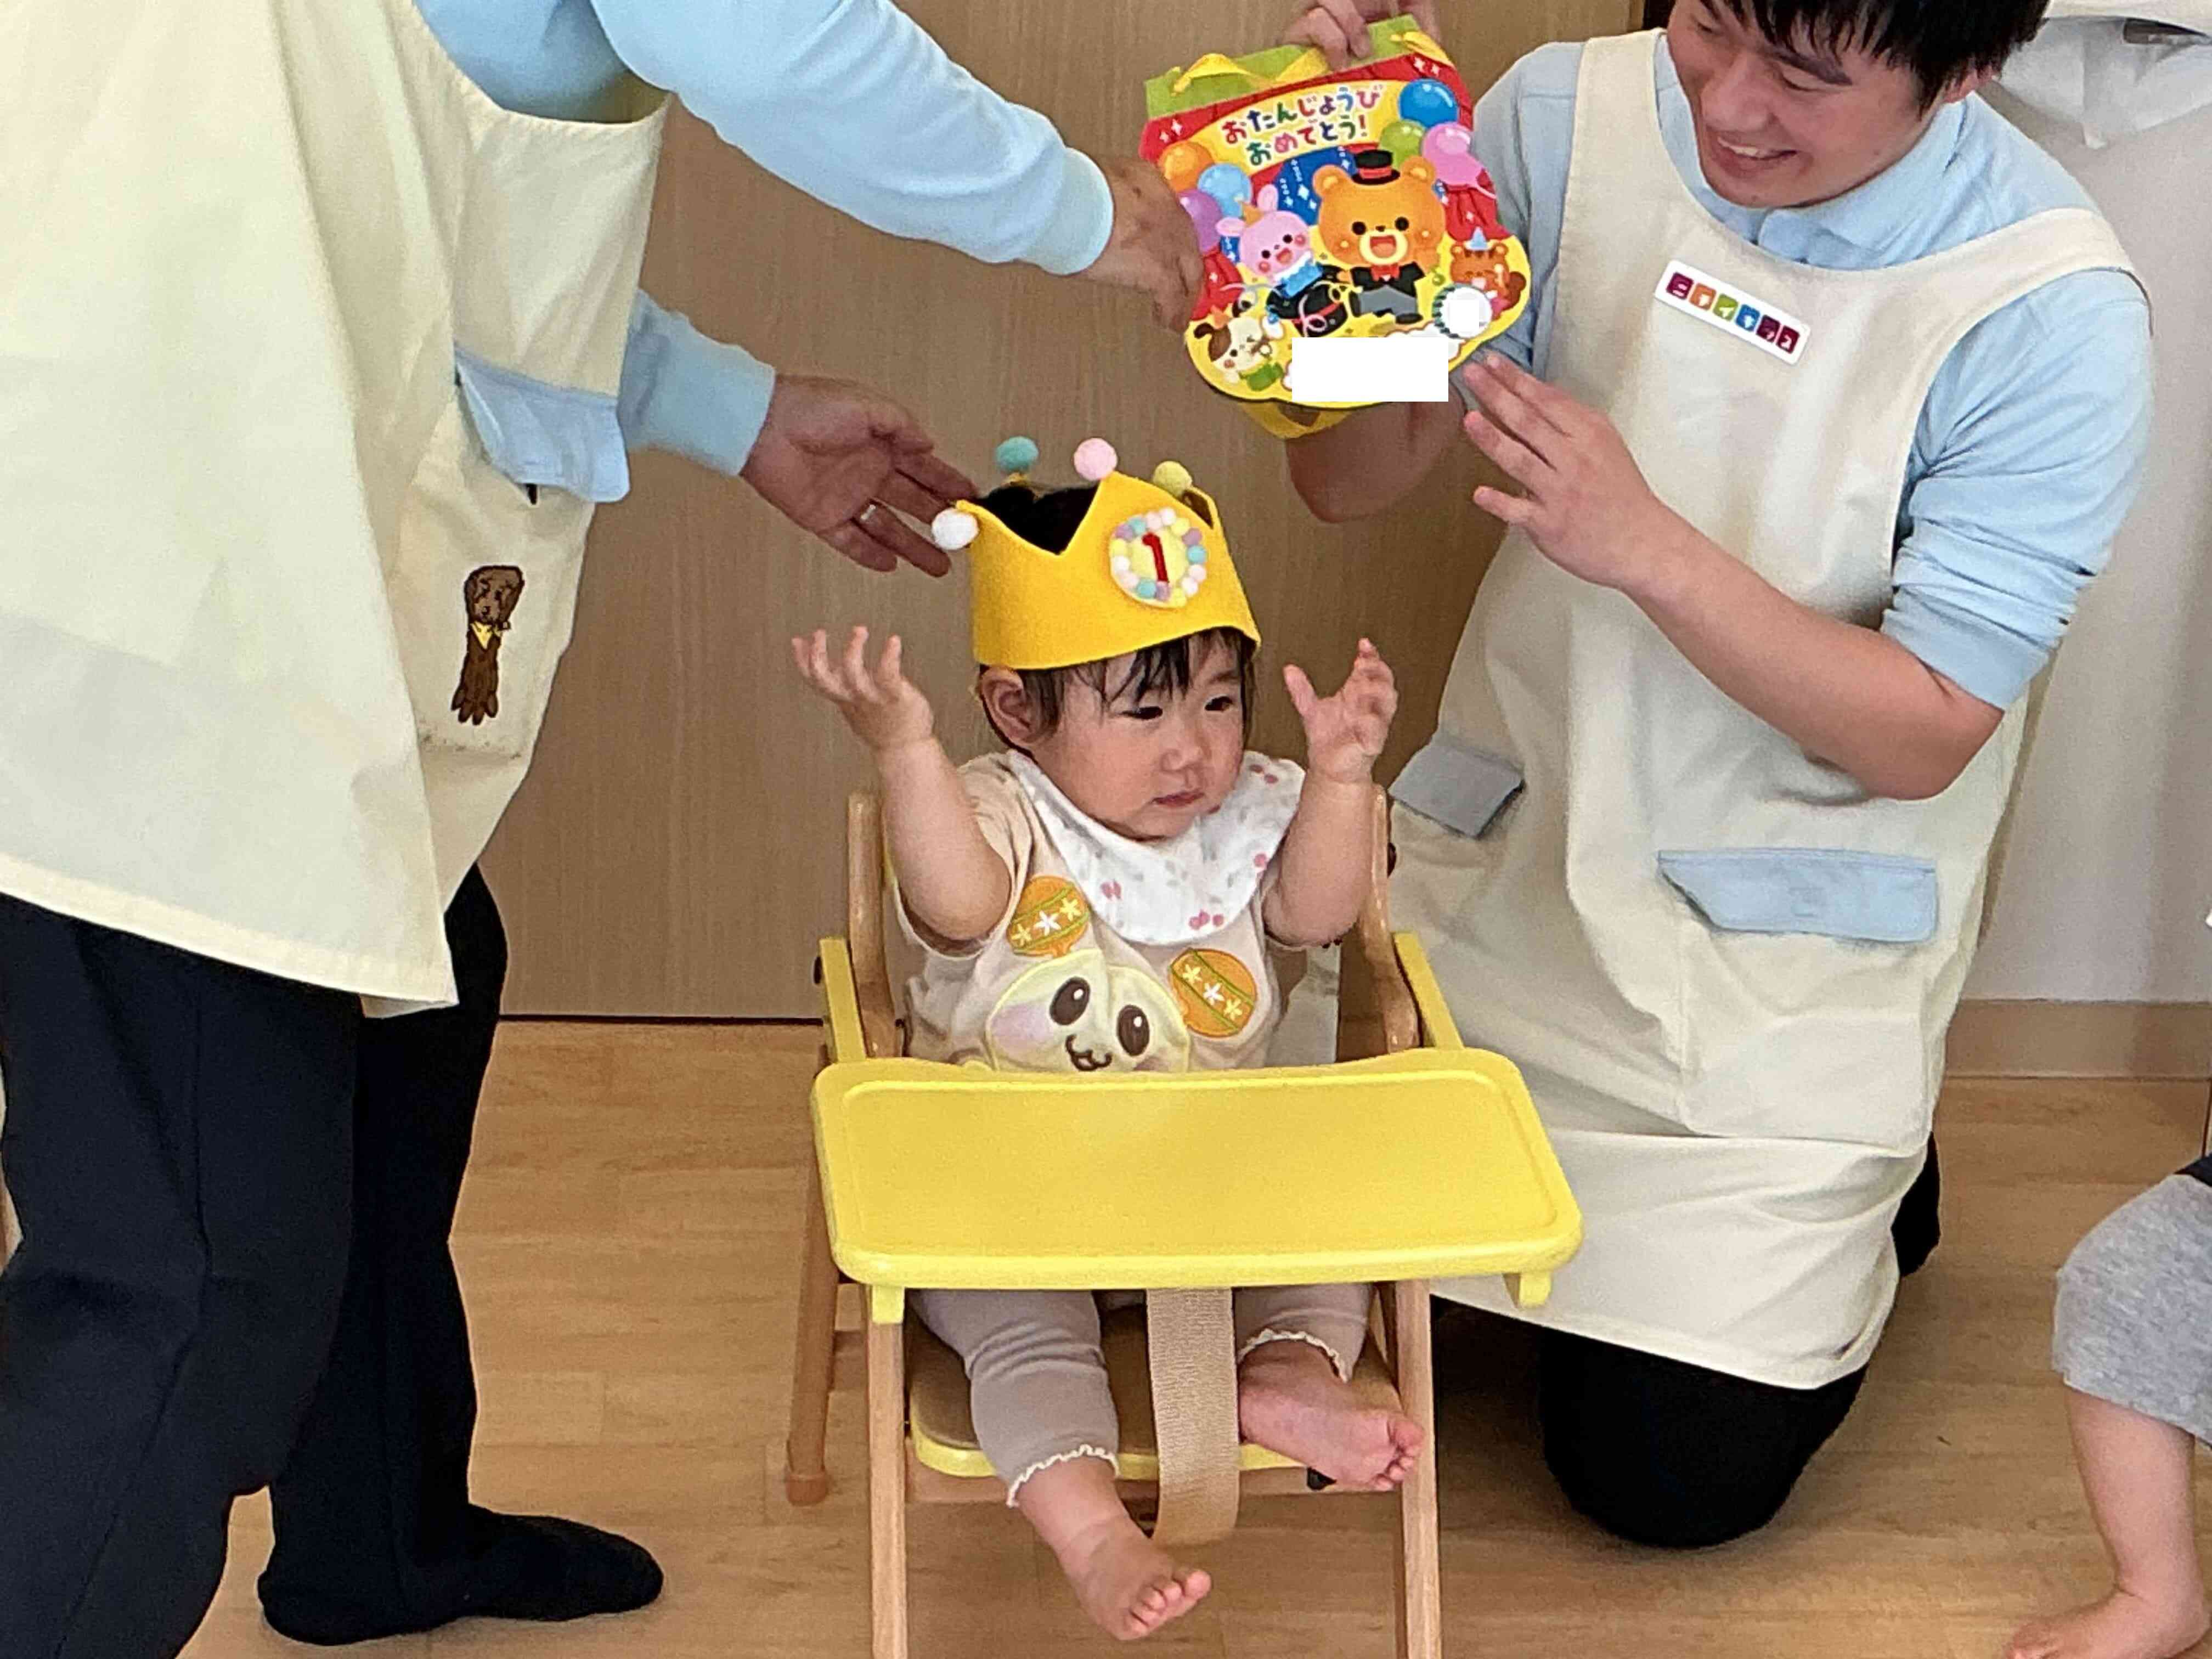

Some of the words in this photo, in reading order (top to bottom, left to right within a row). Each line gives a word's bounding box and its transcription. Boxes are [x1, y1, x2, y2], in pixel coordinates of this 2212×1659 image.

[1222, 84, 1383, 144] おたんじょうび
[1142, 532, 1169, 583] 1
